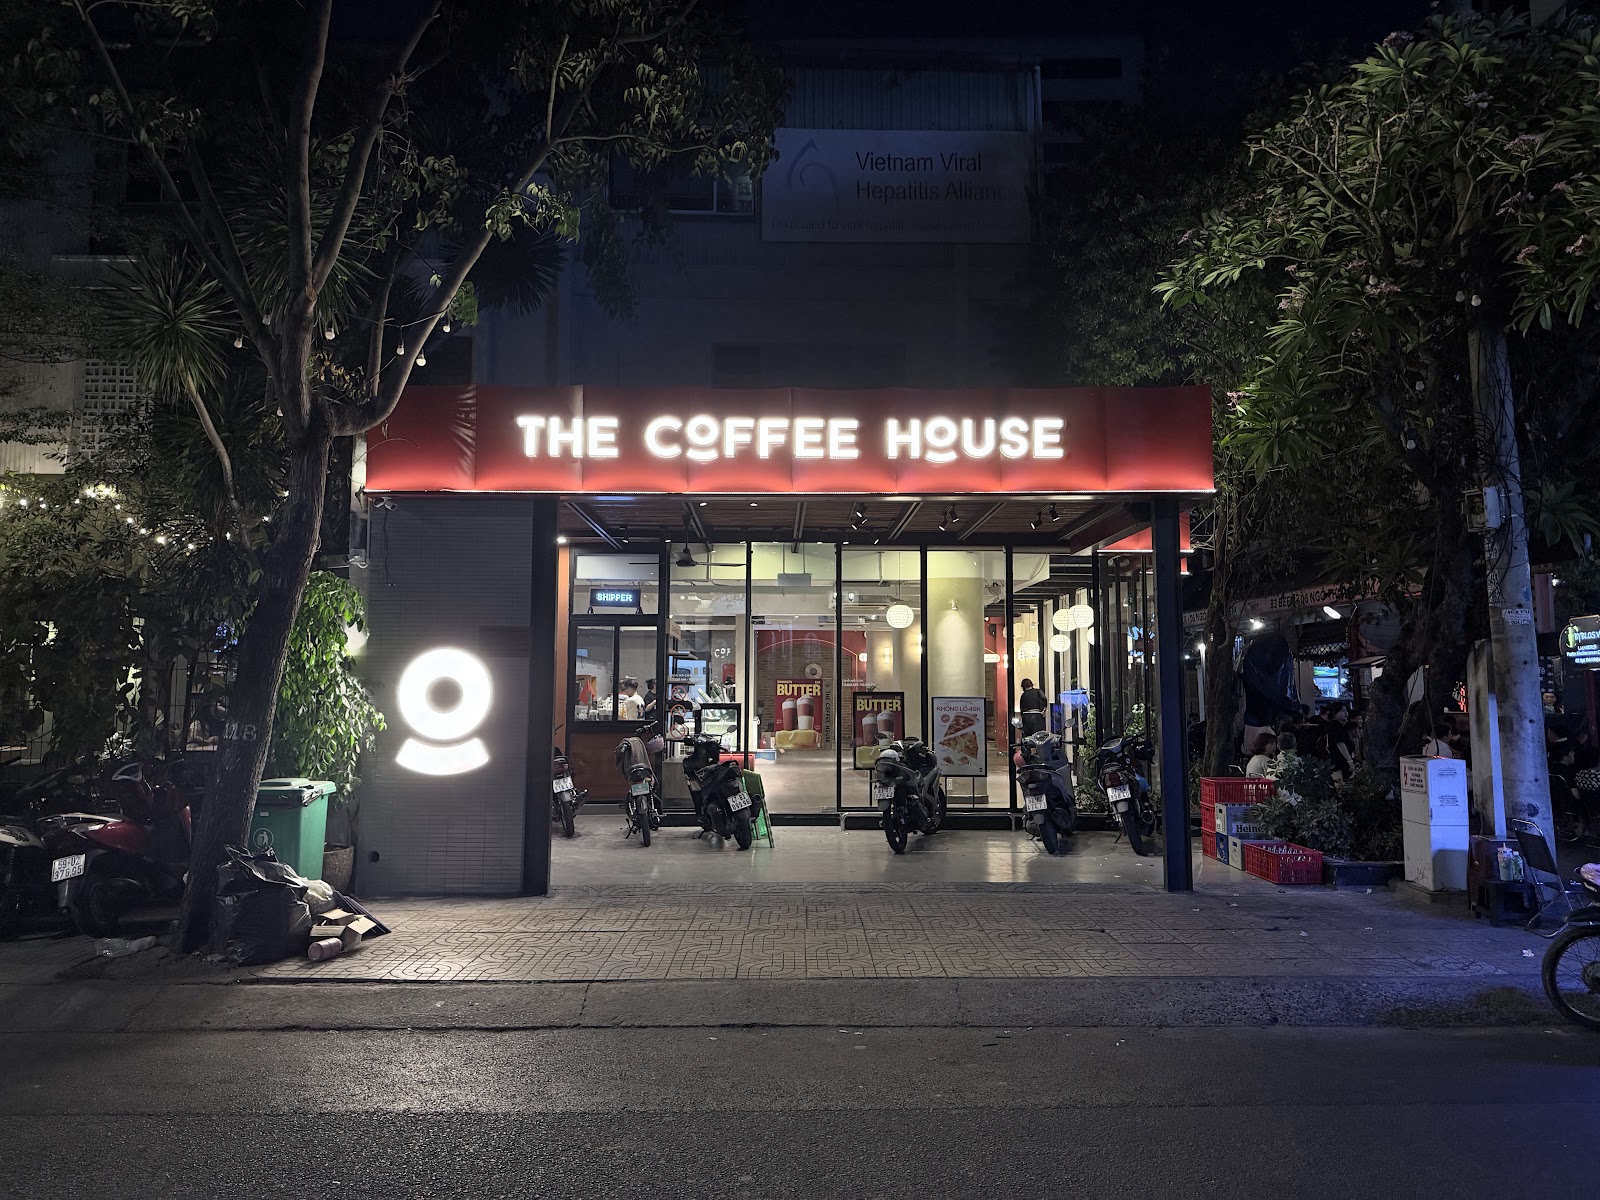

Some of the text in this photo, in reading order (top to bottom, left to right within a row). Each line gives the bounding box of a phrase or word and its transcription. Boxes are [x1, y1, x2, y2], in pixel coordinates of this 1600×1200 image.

[856, 152, 982, 172] Vietnam Viral
[857, 180, 1005, 204] Hepatitis Allian
[517, 415, 1065, 463] THE COFFEE HOUSE
[596, 592, 633, 602] SHIPPER
[776, 684, 821, 696] BUTTER
[856, 699, 901, 711] BUTTER
[1236, 824, 1264, 833] Heine
[54, 864, 82, 880] 376.95
